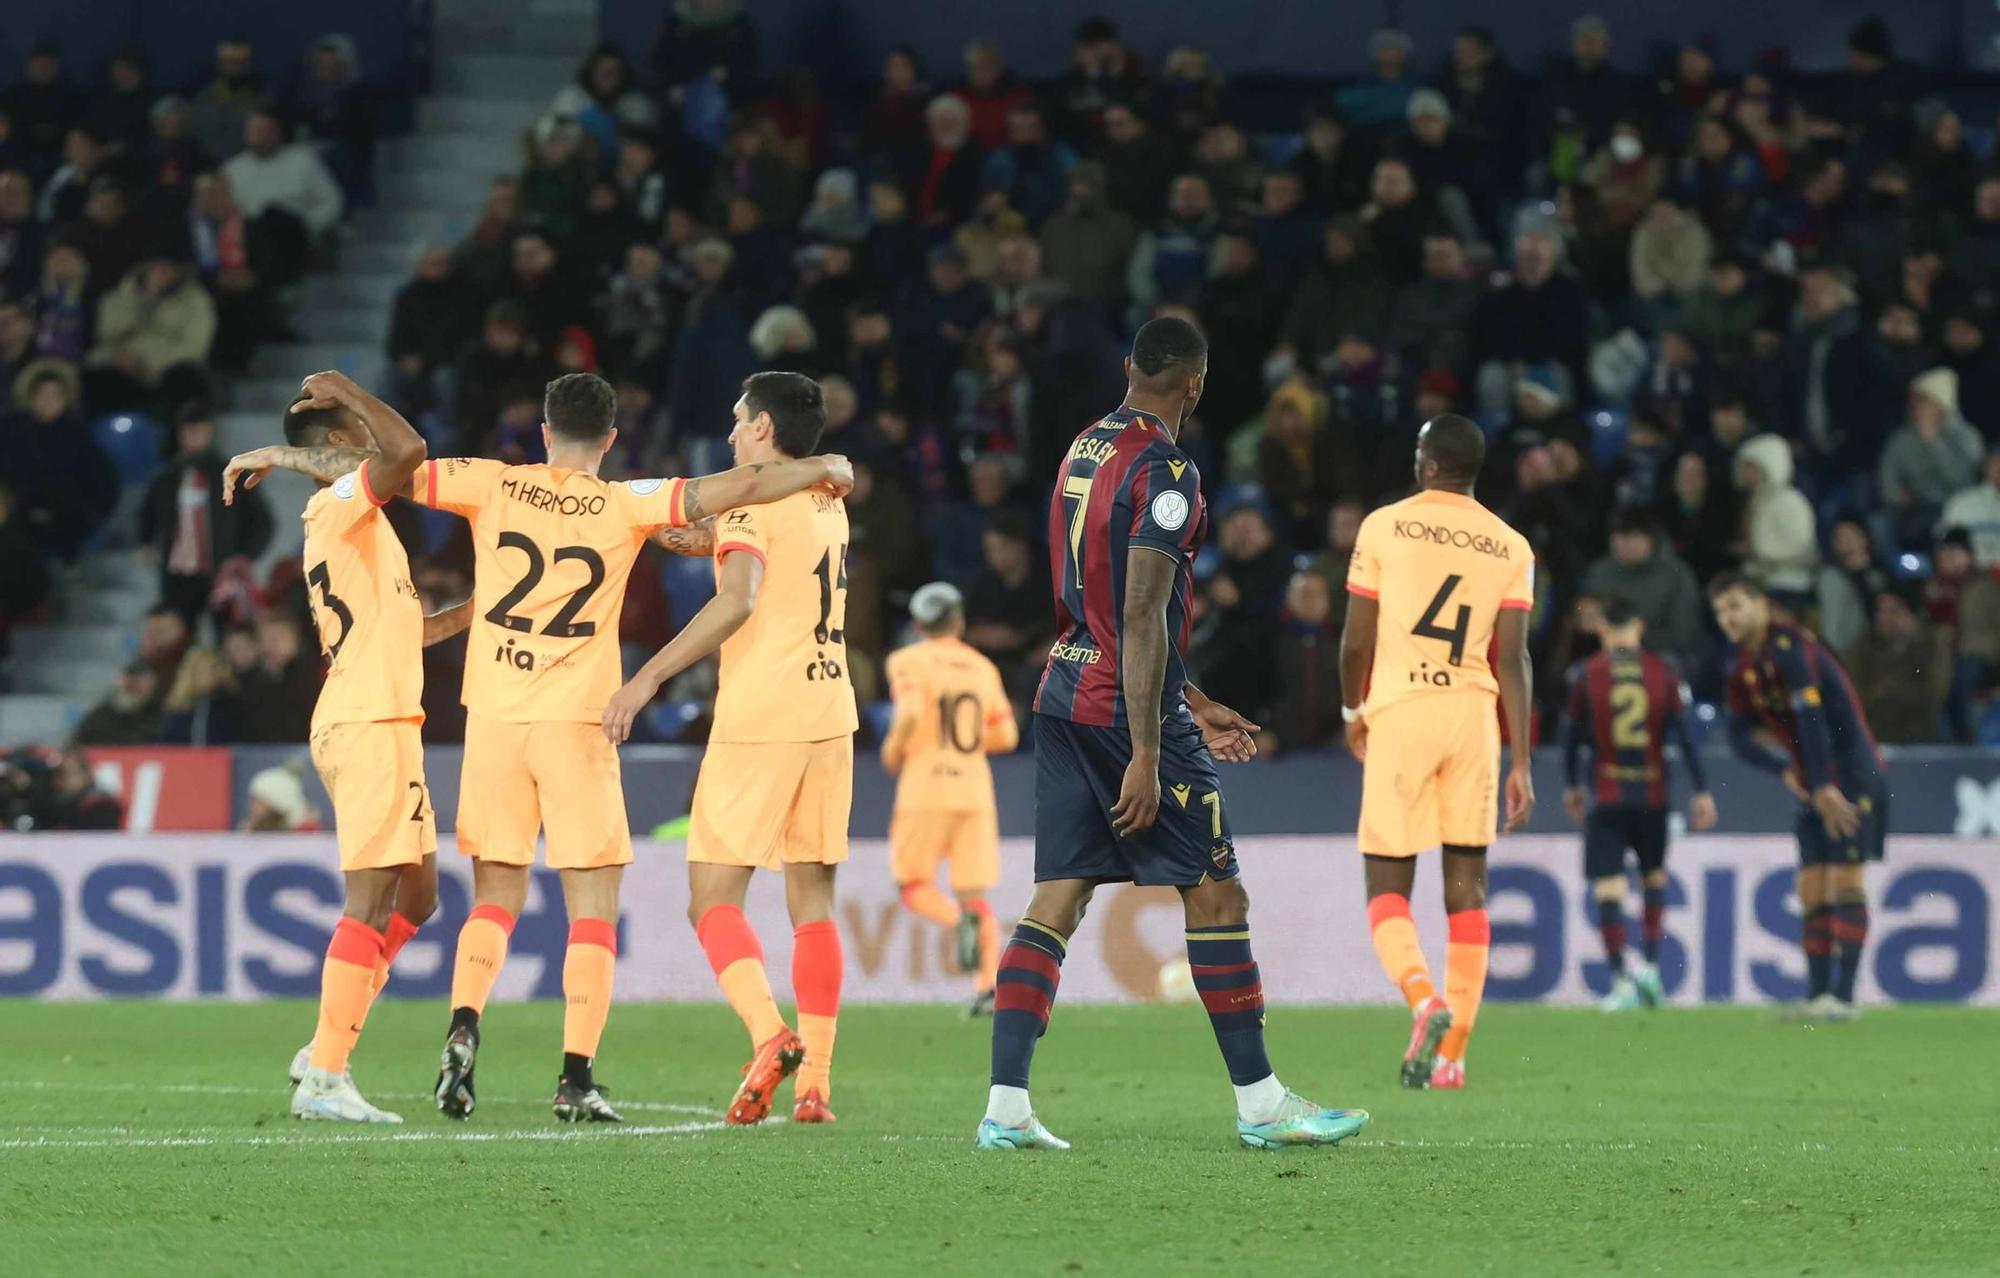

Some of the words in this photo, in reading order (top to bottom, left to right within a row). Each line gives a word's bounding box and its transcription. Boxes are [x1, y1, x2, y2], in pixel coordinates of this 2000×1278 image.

[1062, 475, 1094, 589] 7
[1393, 519, 1510, 561] KONDOGBIA
[484, 530, 606, 638] 22
[1410, 574, 1473, 668] 4
[495, 638, 535, 671] ria
[806, 651, 842, 681] ria
[1409, 662, 1451, 687] ria
[938, 691, 983, 754] 10
[1610, 681, 1651, 747] 2
[1202, 790, 1222, 839] 7
